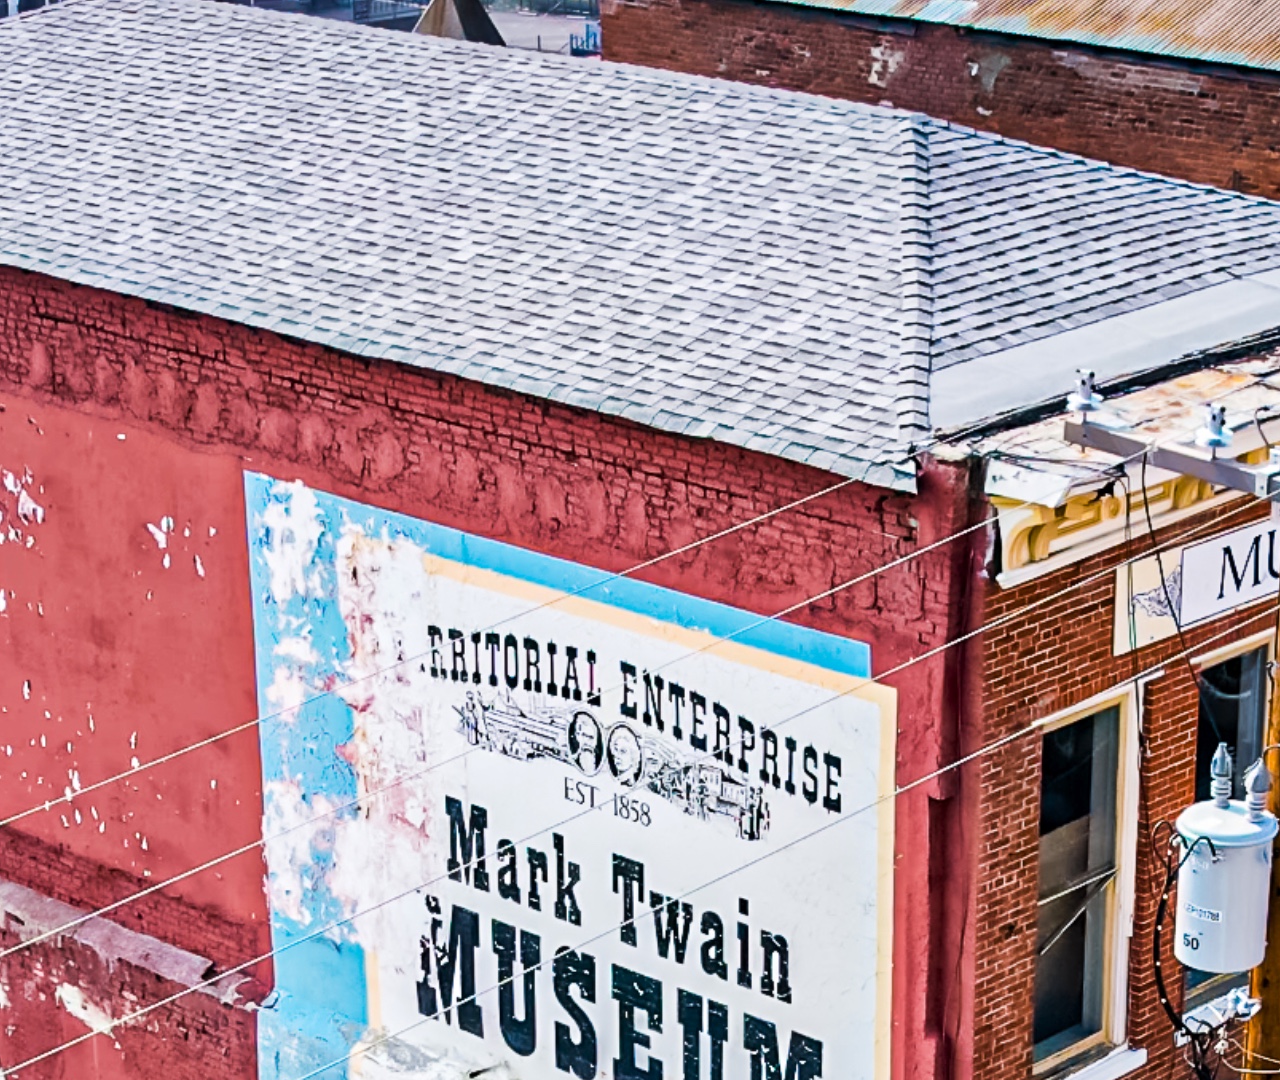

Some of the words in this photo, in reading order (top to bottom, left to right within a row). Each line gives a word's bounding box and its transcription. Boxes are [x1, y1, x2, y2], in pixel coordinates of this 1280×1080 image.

[619, 662, 843, 814] ENTERPRISE
[611, 795, 653, 829] 1858
[444, 795, 583, 926] Mark
[611, 853, 793, 1003] Twain
[1183, 932, 1200, 951] 50
